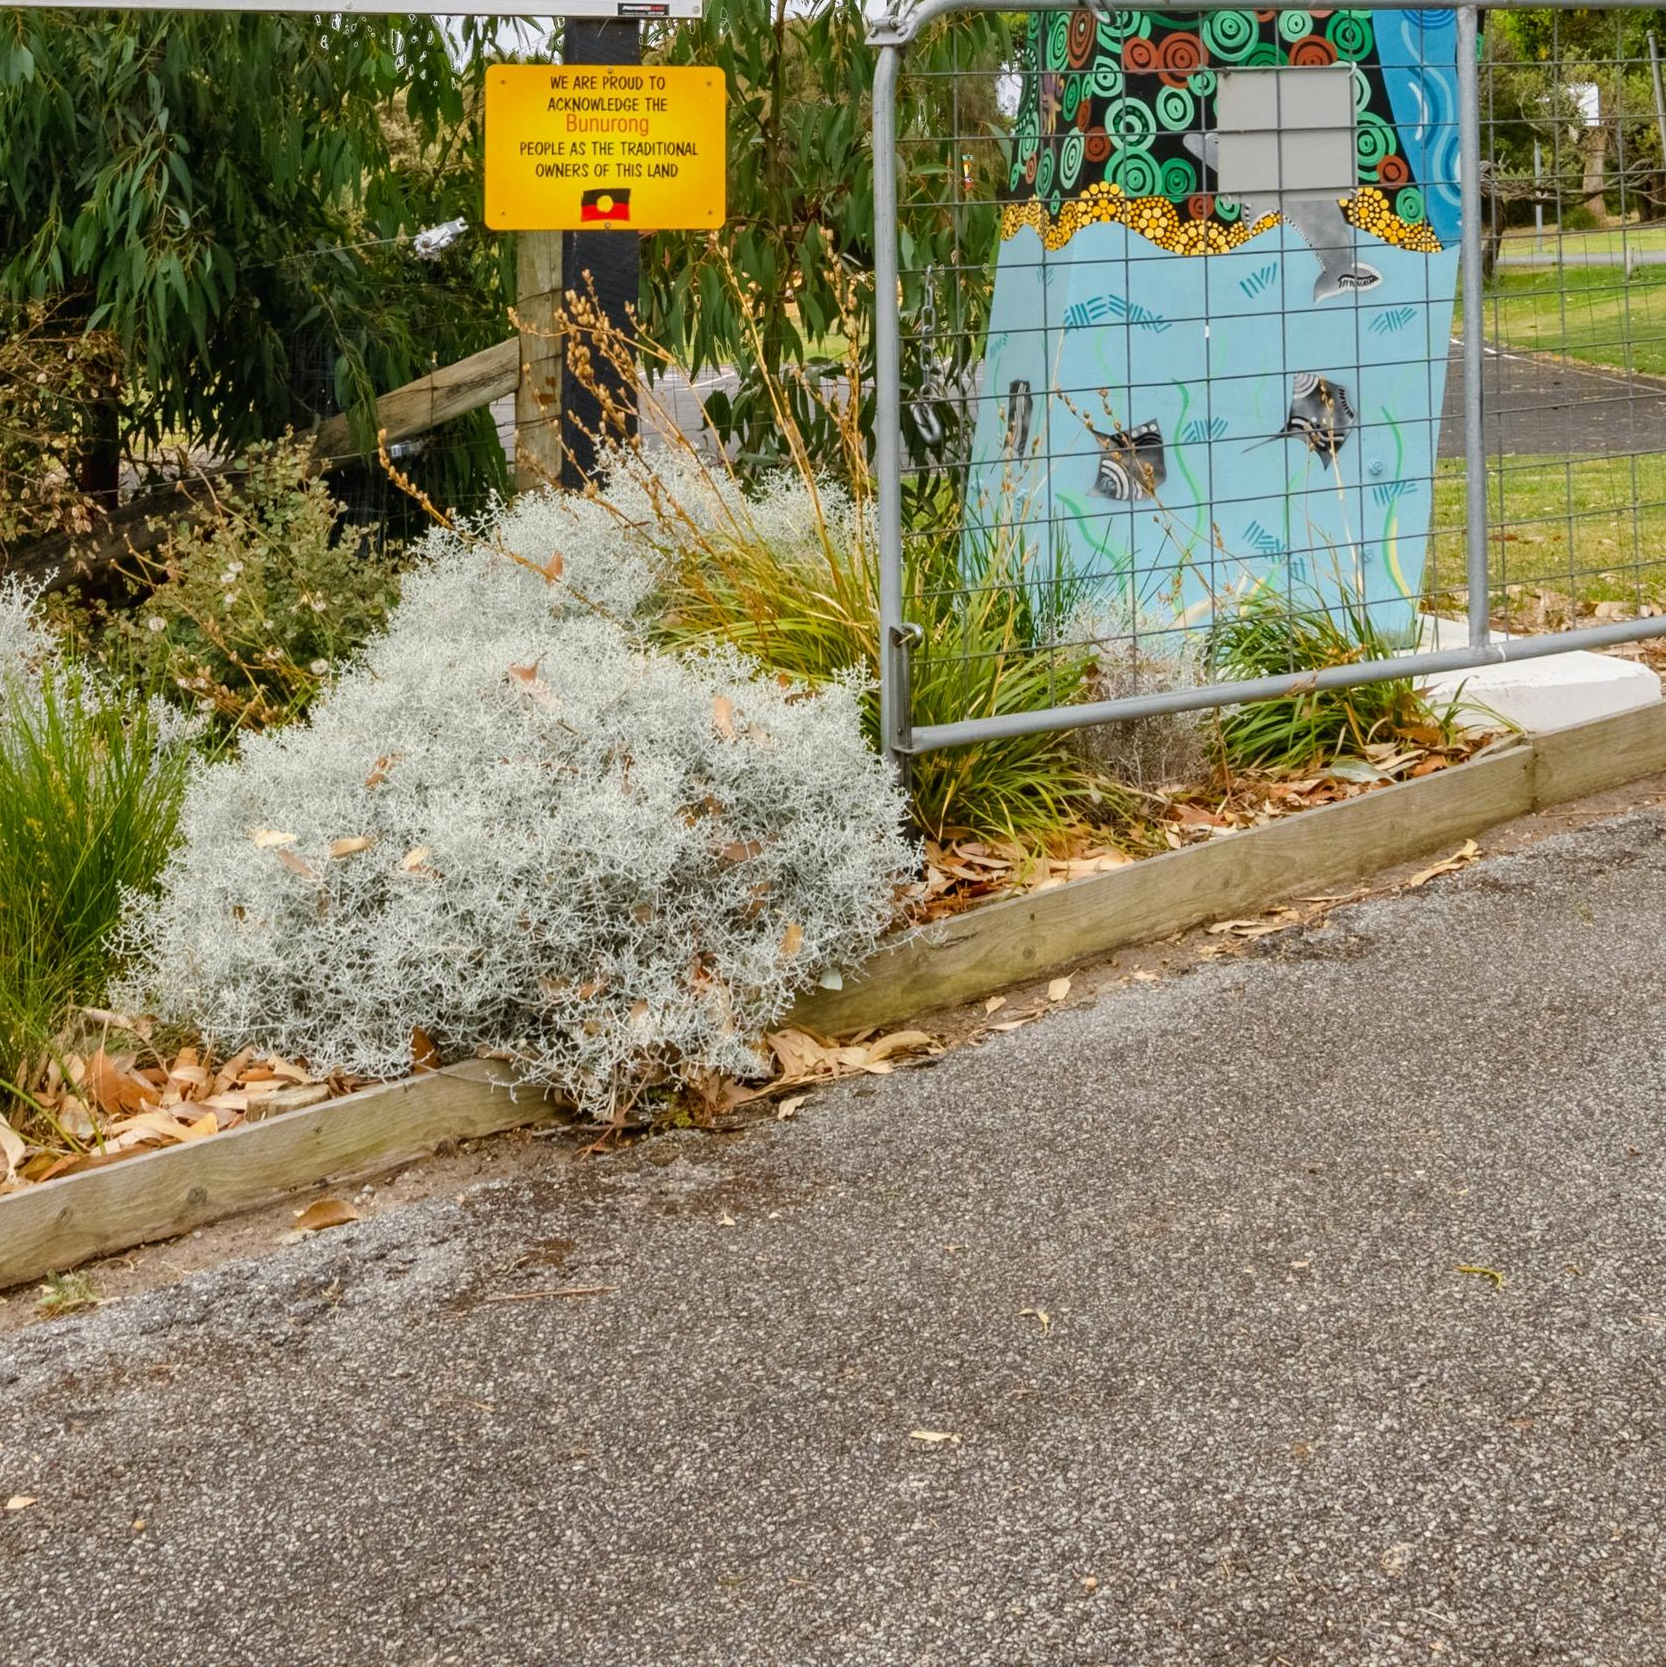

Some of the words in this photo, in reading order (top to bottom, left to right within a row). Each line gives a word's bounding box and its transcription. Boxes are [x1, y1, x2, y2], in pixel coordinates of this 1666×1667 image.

[550, 75, 568, 90] WE
[572, 75, 598, 90] ARE
[602, 76, 644, 91] PROUD
[648, 76, 666, 91] TO
[547, 97, 639, 112] ACKNOWLEDGE
[645, 97, 668, 112] THE
[566, 113, 650, 136] Bunurong
[520, 141, 565, 156] PEOPLE
[569, 141, 586, 156] AS
[591, 141, 615, 156] THE
[620, 141, 699, 156] TRADITIONAL
[535, 163, 589, 178] OWNERS
[594, 163, 610, 178] OF
[615, 163, 642, 178] THIS
[647, 163, 679, 178] LAND
